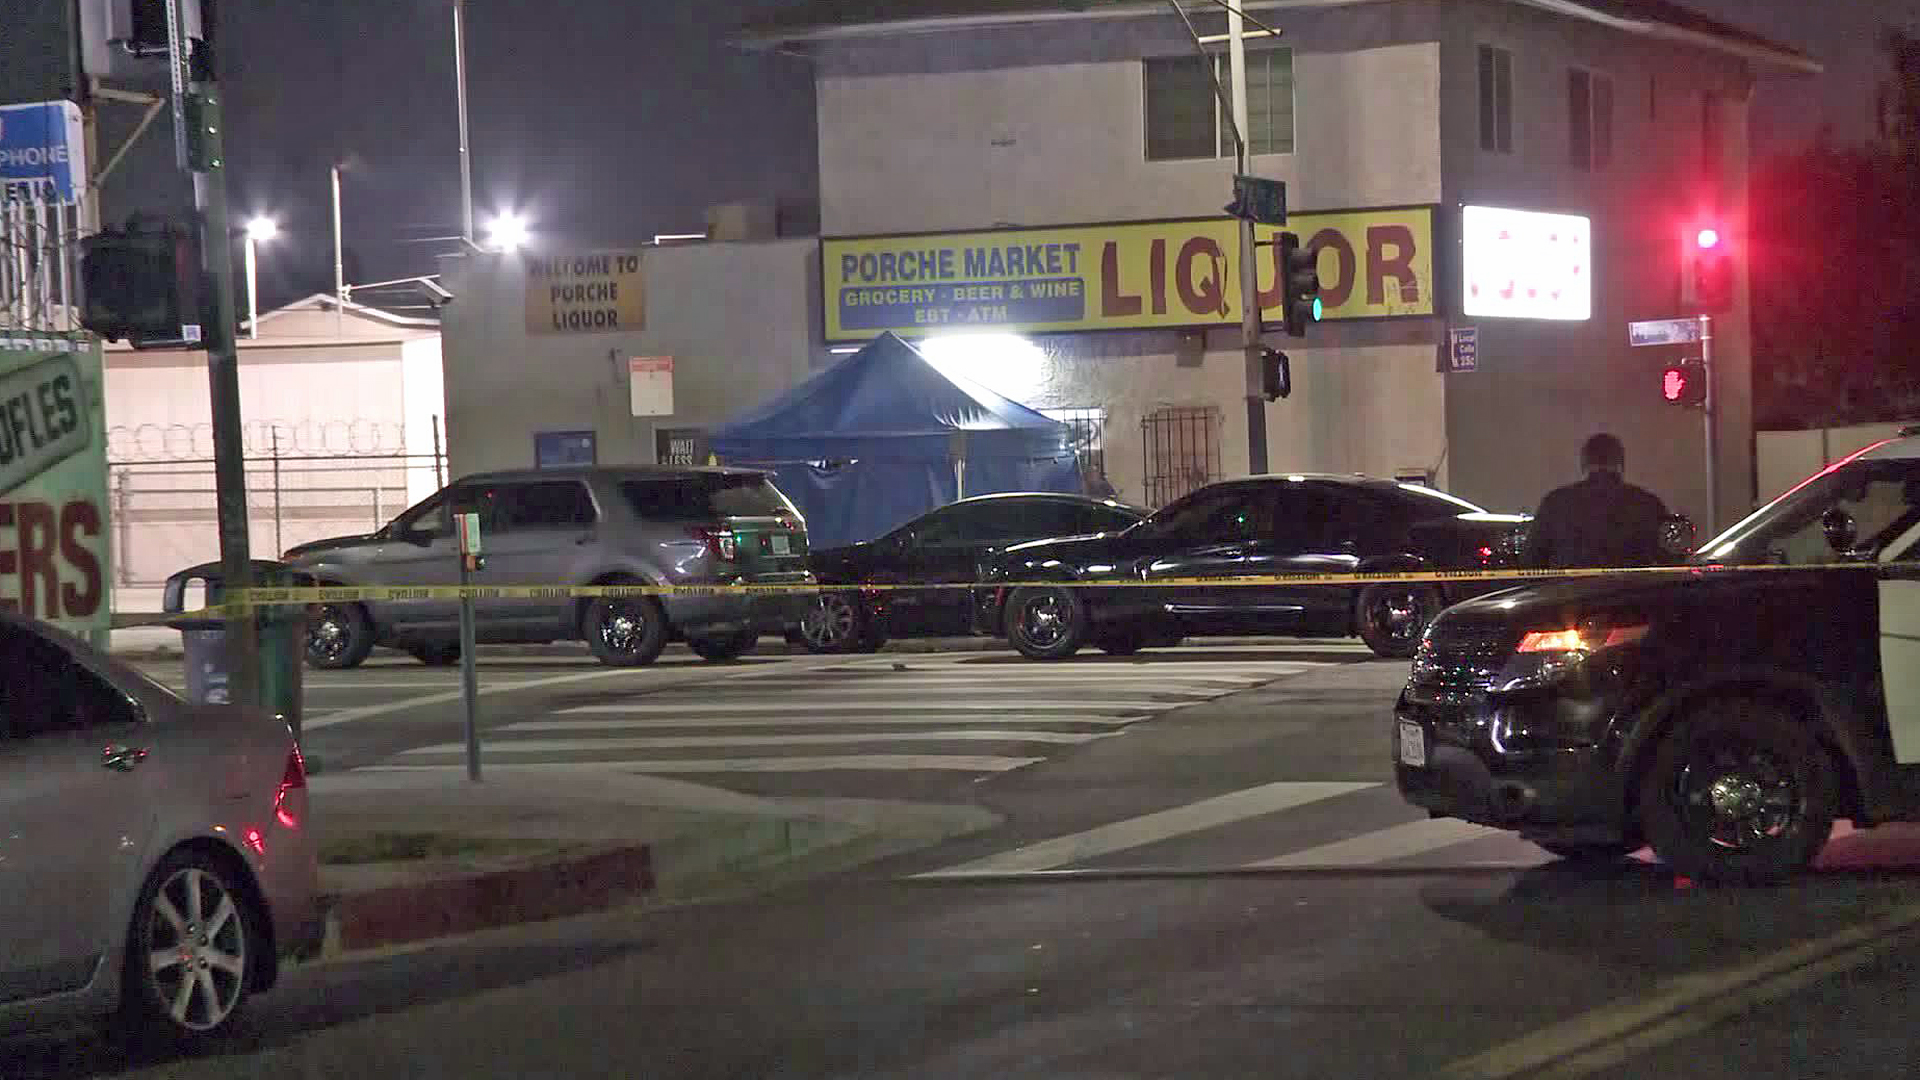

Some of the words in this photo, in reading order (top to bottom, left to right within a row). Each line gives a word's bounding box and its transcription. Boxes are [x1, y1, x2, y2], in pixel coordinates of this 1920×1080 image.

[617, 256, 638, 273] TO
[841, 249, 954, 282] PORCHE
[964, 243, 1080, 277] MARKET
[1101, 225, 1419, 317] LIQUOR
[551, 282, 618, 303] PORCHE
[845, 289, 935, 307] GROCERY
[953, 285, 1004, 301] BEER
[1009, 284, 1024, 299] &
[1030, 281, 1079, 298] WINE
[552, 309, 618, 329] LIQUOR
[915, 306, 950, 323] EBT
[964, 305, 1008, 323] ATM
